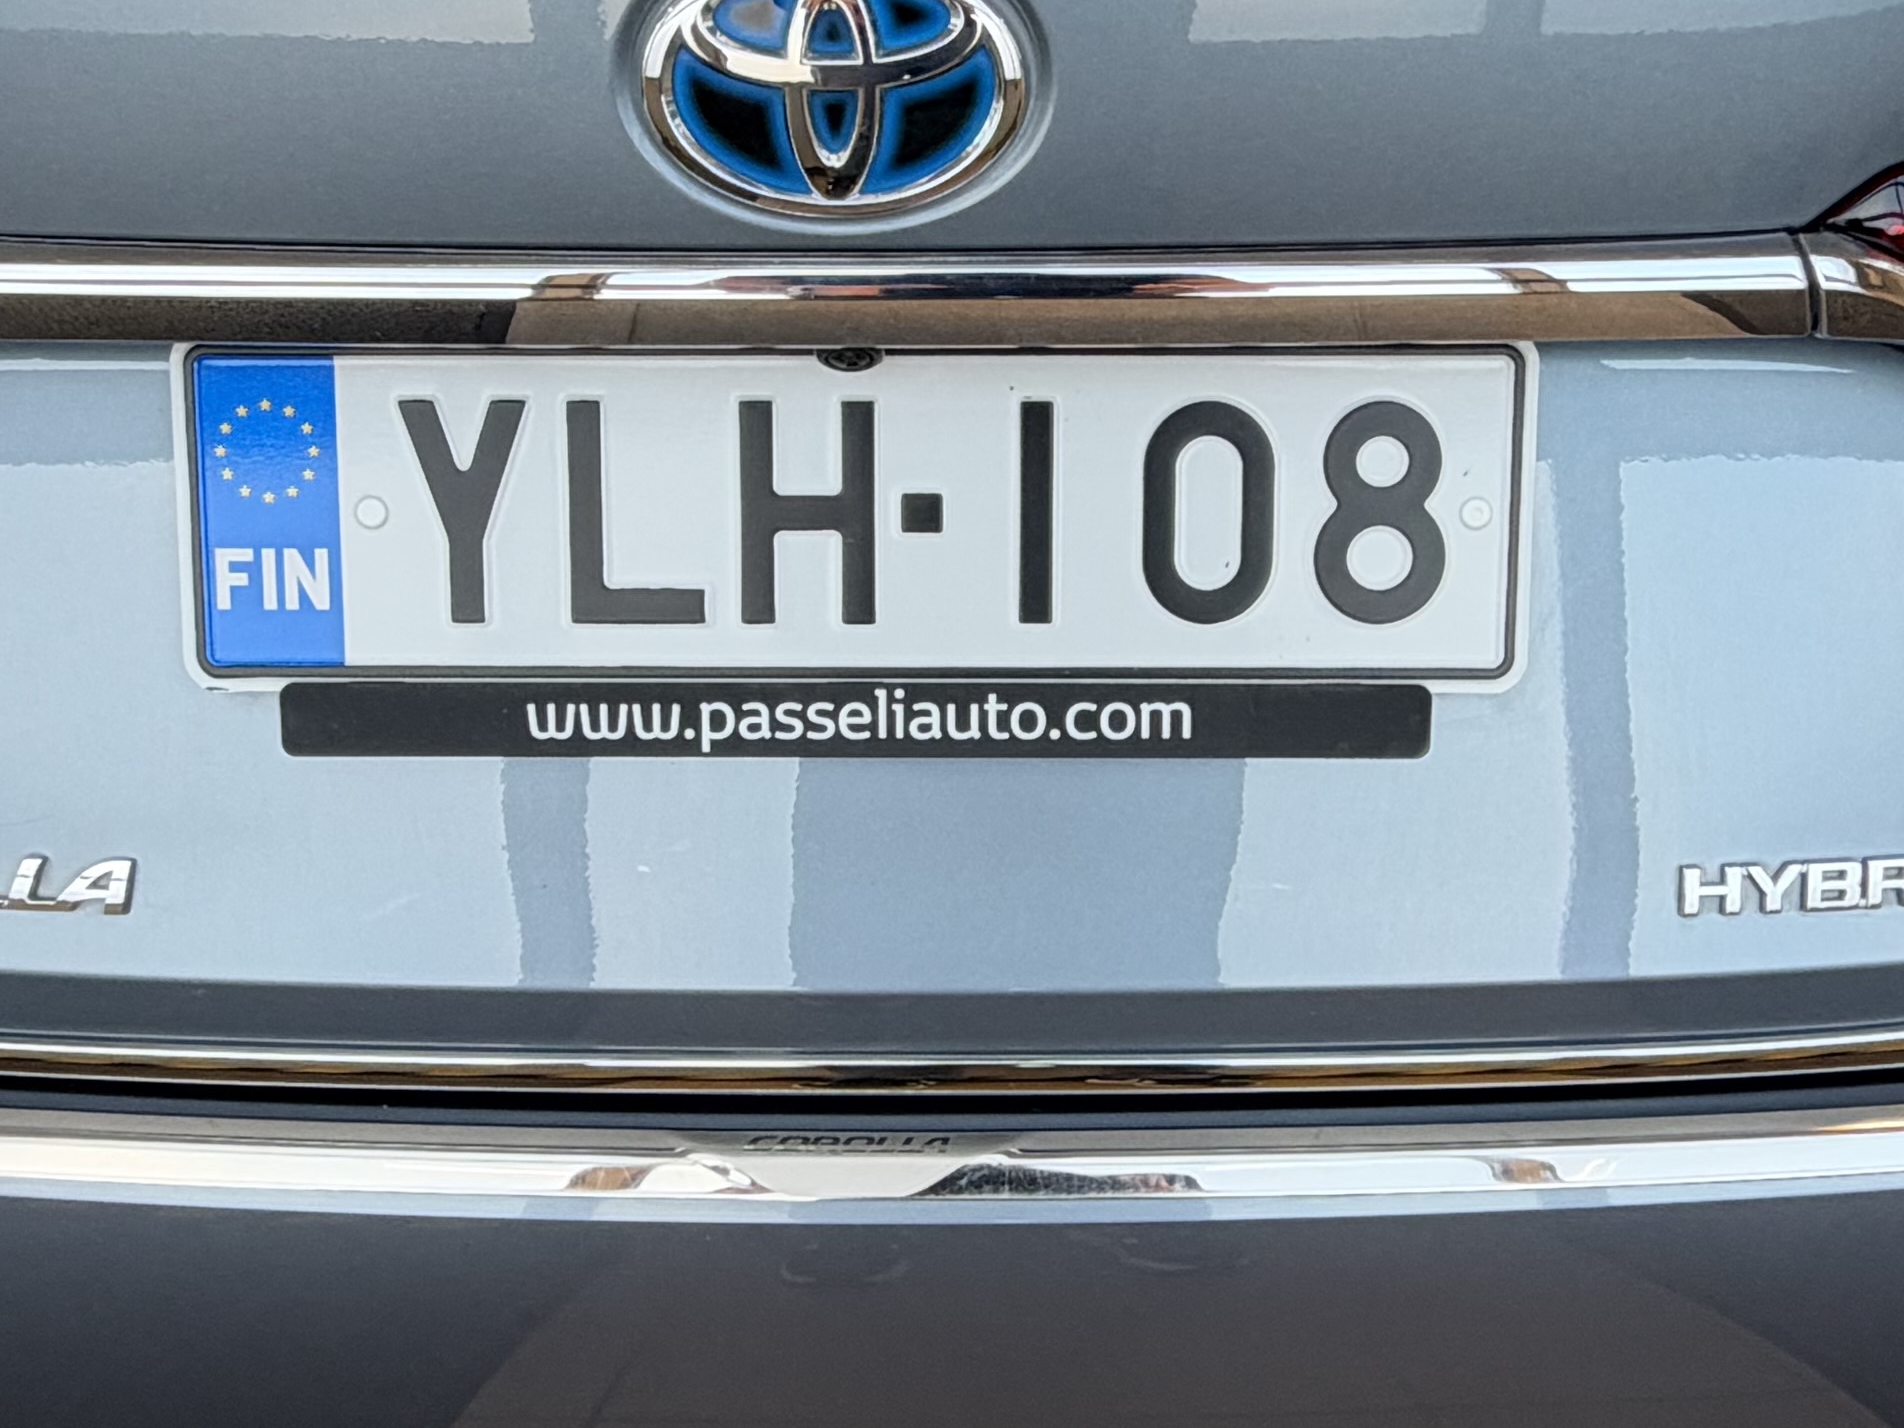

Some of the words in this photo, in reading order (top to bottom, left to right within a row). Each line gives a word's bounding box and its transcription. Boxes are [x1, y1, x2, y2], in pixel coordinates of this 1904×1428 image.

[397, 399, 1447, 626] YLH-108
[213, 547, 332, 612] FIN
[526, 688, 1193, 753] www.passeliauto.com
[742, 1134, 952, 1154] COROLLA
